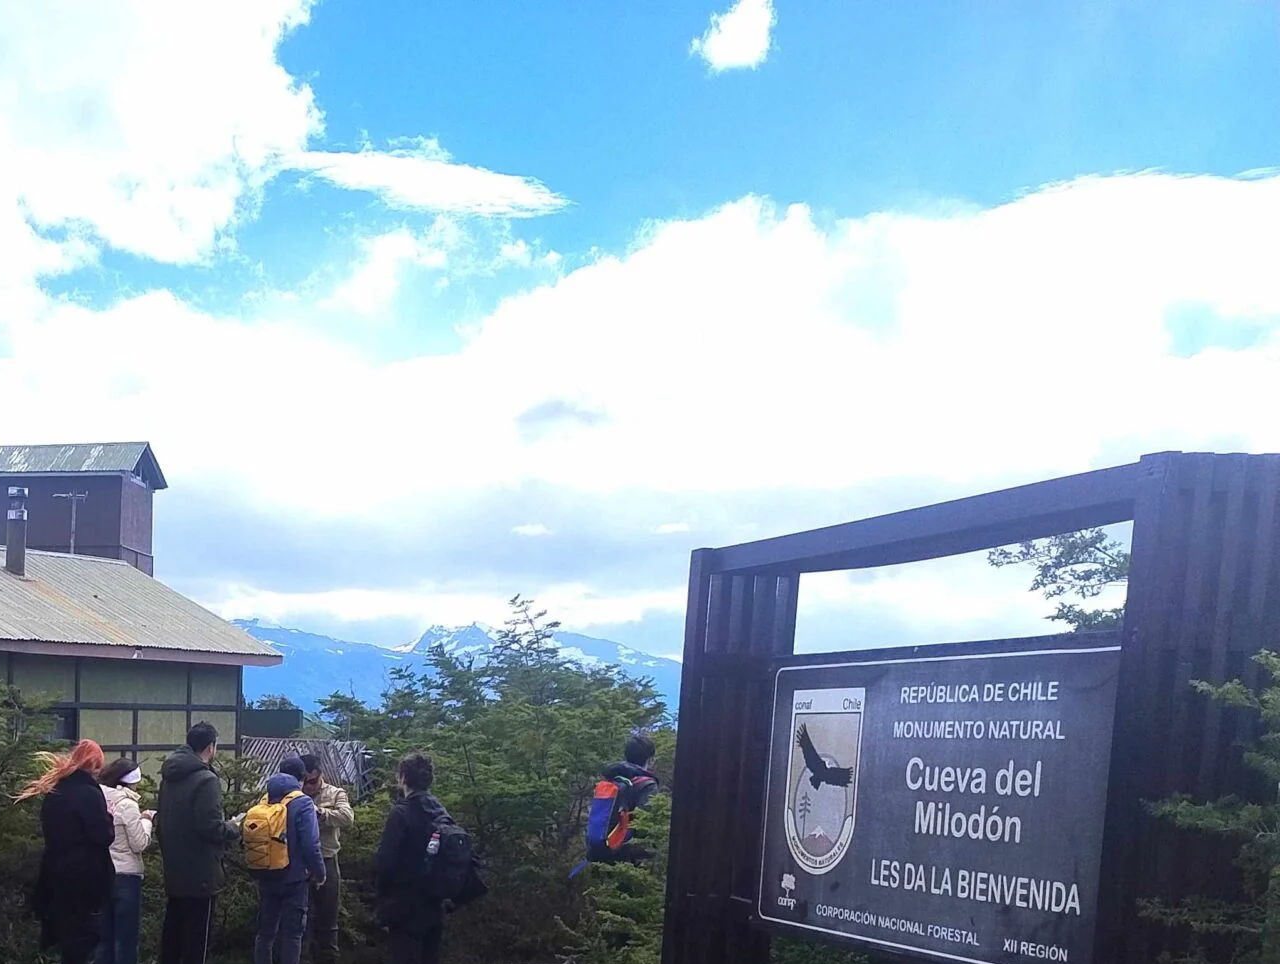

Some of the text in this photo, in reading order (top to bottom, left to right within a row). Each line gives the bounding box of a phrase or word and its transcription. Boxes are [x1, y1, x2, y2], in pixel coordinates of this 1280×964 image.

[842, 697, 862, 711] Chile
[900, 681, 1059, 704] REPÚBLICA DE CHILE
[893, 720, 1066, 740] MONUMENTO NATURAL
[905, 756, 1042, 797] Cueva del
[914, 800, 1021, 843] Milodón
[871, 857, 1081, 916] LES DA LA BIENVENIDA
[815, 903, 1068, 963] CORPORACIÓN NACIONAL FORESTAL XII REGIÓN
